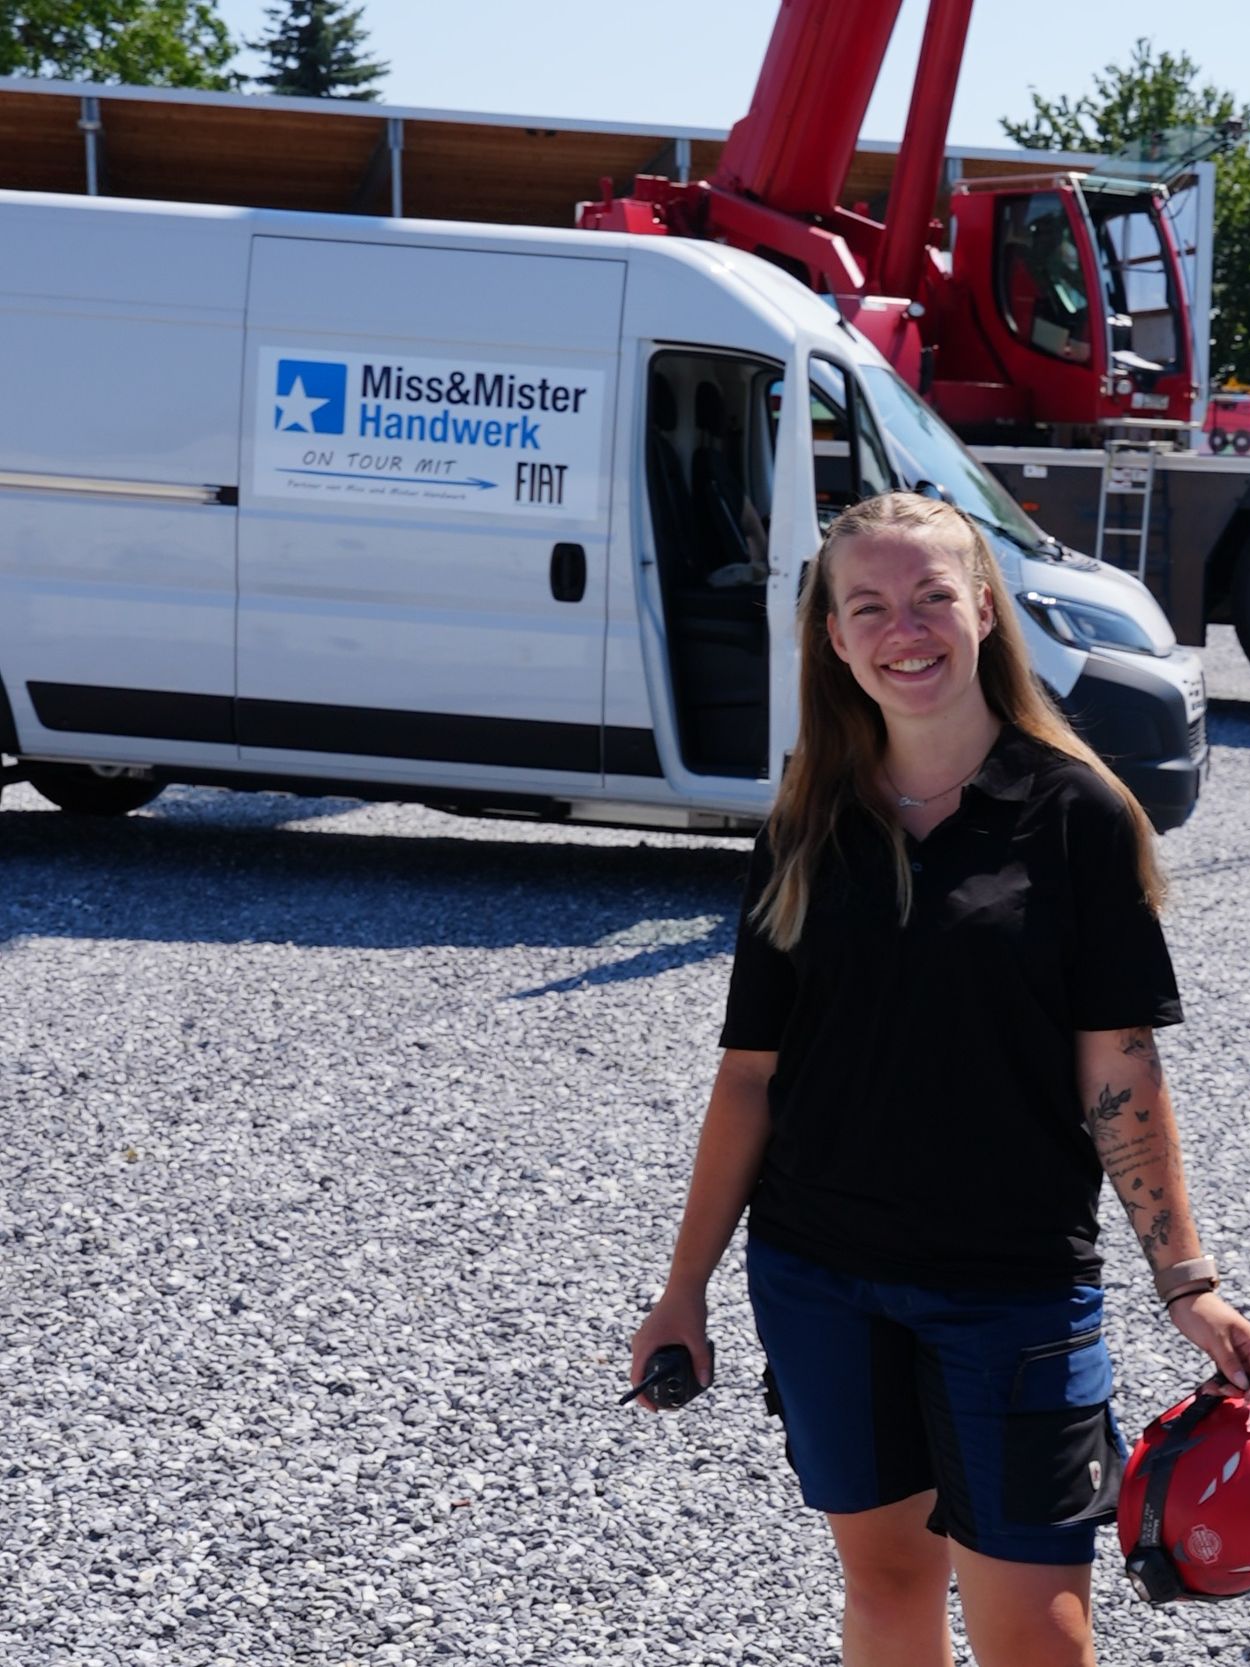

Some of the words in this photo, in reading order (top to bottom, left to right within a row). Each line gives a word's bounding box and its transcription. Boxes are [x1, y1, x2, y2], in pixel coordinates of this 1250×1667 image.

[361, 364, 587, 414] Miss&Mister
[359, 403, 542, 450] Handwerk
[302, 450, 334, 467] ON
[347, 453, 402, 471] TOUR
[414, 459, 457, 475] MIT
[515, 462, 568, 504] FIAT
